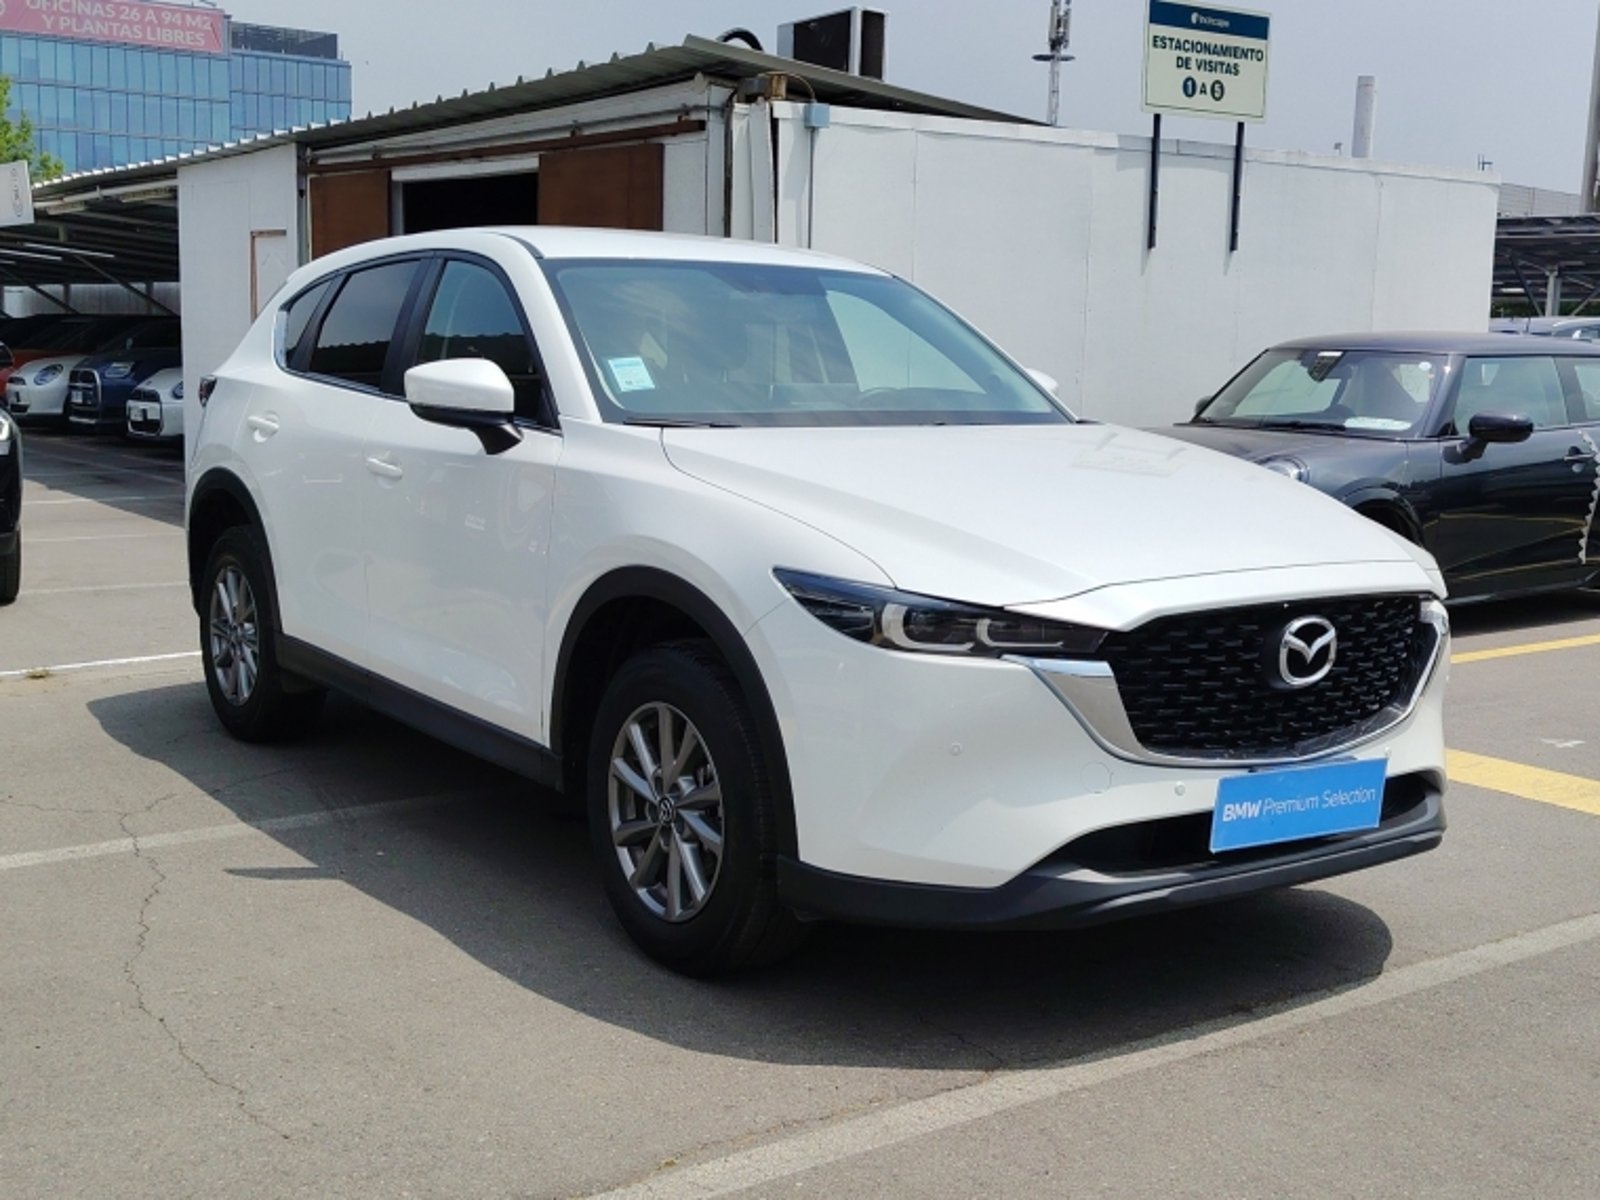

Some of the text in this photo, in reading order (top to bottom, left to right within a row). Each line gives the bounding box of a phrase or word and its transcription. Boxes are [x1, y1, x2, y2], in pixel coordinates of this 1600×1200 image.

[26, 0, 116, 18] OFICINAS
[119, 6, 141, 21] 26
[144, 8, 158, 24] A
[161, 10, 182, 26] 94
[185, 14, 211, 31] M2
[41, 14, 206, 47] Y PLANTAS LIBRES
[1152, 35, 1264, 62] ESTACIONAMIENTO
[1176, 56, 1240, 76] DE VISITAS
[1199, 82, 1207, 96] A
[1222, 786, 1376, 822] BMW Premium Selection
